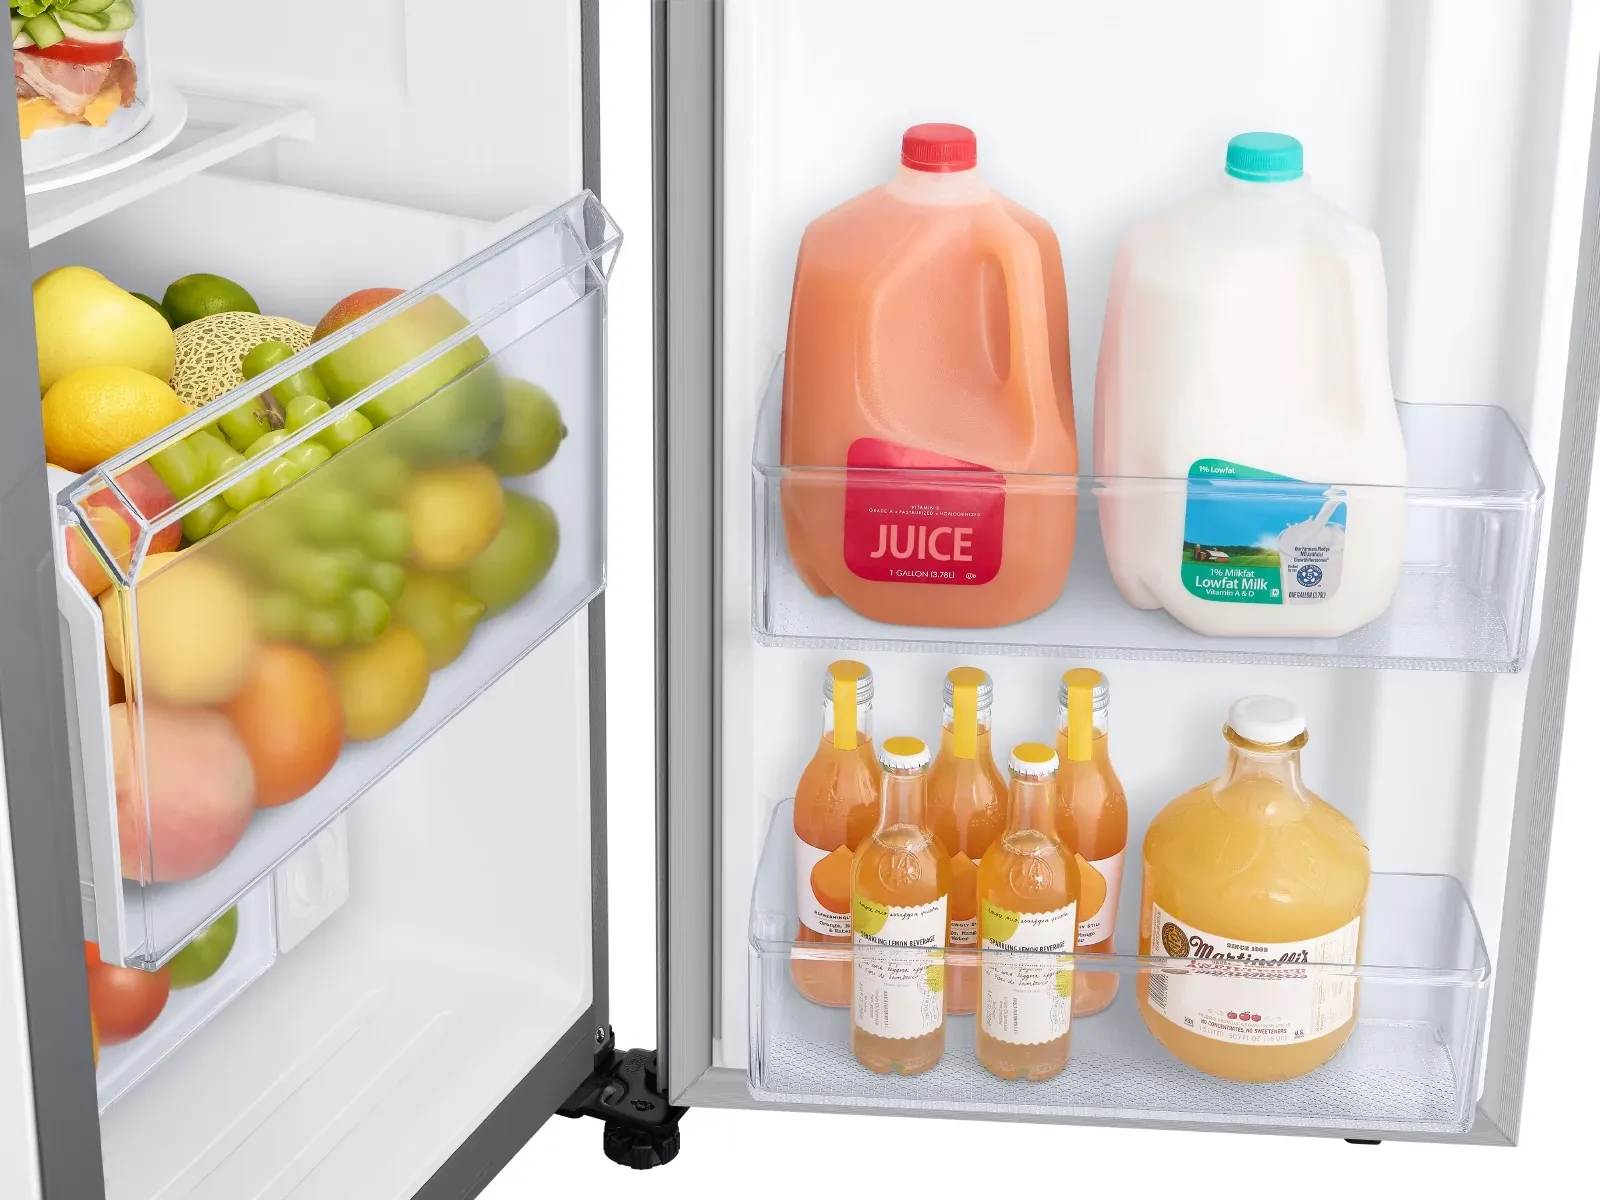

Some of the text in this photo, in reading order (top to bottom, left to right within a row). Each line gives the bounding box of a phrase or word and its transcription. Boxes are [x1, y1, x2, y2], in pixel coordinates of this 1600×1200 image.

[1210, 466, 1236, 474] Lowfat
[870, 524, 973, 562] JUICE
[896, 569, 928, 578] GALLON
[1210, 568, 1255, 578] 1% Milkfat
[1195, 575, 1268, 591] Lowfat Milk
[1206, 588, 1234, 597] Vitamin
[860, 930, 888, 947] SPARKLING
[909, 934, 936, 947] BEVERAGE
[989, 937, 1065, 953] SPARKLING LEMON BEVERAGE
